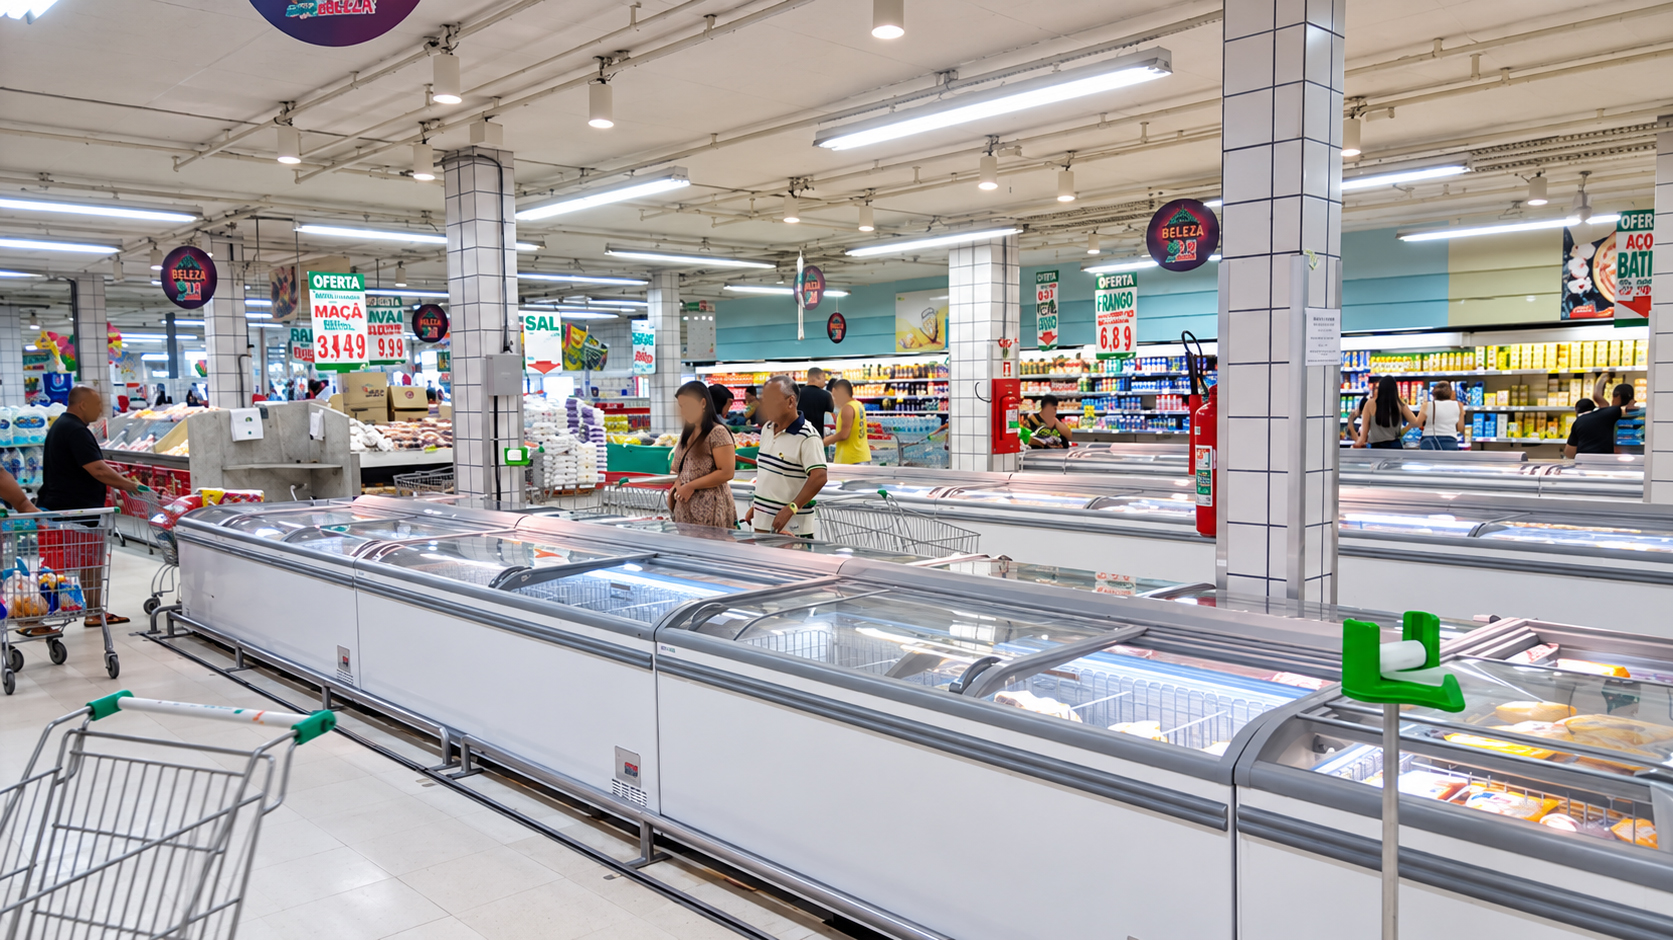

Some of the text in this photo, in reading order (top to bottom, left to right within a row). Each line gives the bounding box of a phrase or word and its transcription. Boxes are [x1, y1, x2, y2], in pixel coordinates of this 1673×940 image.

[1162, 224, 1204, 239] BELEZA
[172, 269, 206, 280] BELEZA
[313, 274, 360, 289] OFERTA
[1098, 274, 1134, 289] OFERTA
[1097, 291, 1133, 312] FRANGO
[525, 315, 559, 331] SAL
[1100, 325, 1132, 352] 6,89
[378, 338, 403, 358] 9,99
